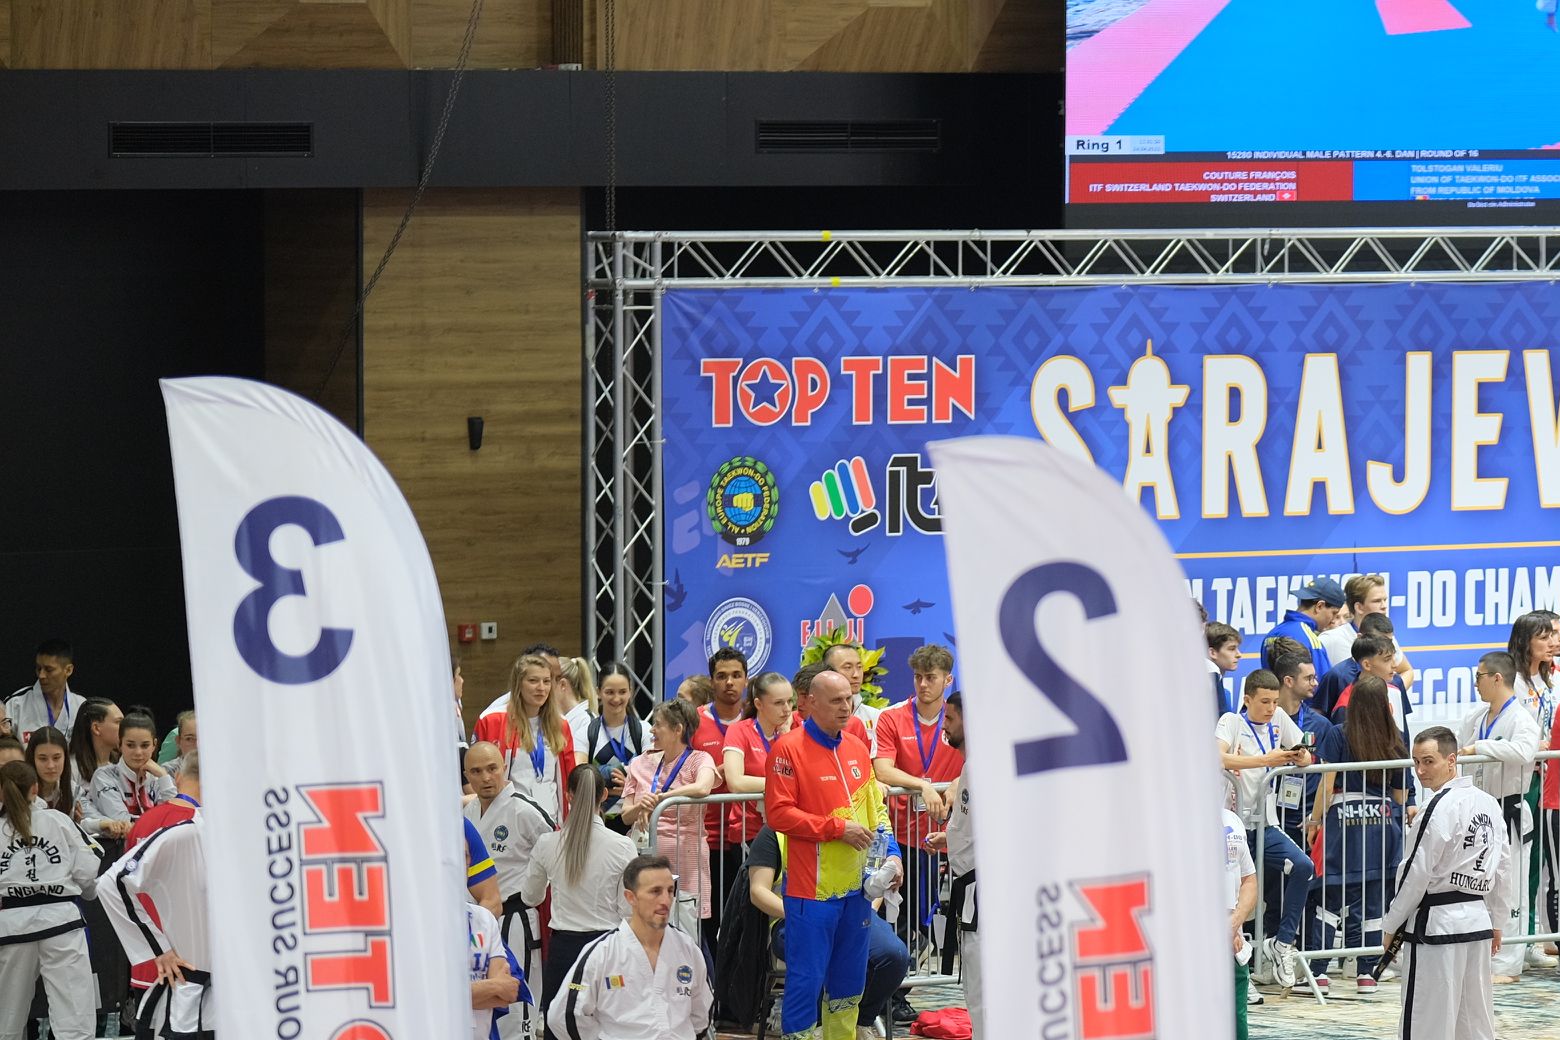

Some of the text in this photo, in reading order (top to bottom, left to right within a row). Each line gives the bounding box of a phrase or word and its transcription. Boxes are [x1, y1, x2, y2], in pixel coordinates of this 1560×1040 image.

[1077, 139, 1109, 152] Ring
[1116, 140, 1123, 150] 1
[1253, 151, 1304, 159] INDIVIDUAL
[1306, 151, 1332, 159] MALE
[1332, 150, 1374, 159] PATTERN
[1395, 150, 1415, 158] DAN
[1420, 150, 1453, 158] ROUND
[1454, 150, 1467, 158] OF
[1203, 171, 1248, 180] COUTURE
[1441, 175, 1454, 183] OF
[1089, 182, 1296, 192] ITF SWITZERLAND TAEKWON-DO FEDERATION
[1210, 194, 1276, 202] SWITZERLAND
[700, 353, 976, 428] TOP TEN
[715, 553, 770, 569] AETF
[8, 885, 64, 897] ENGLAND
